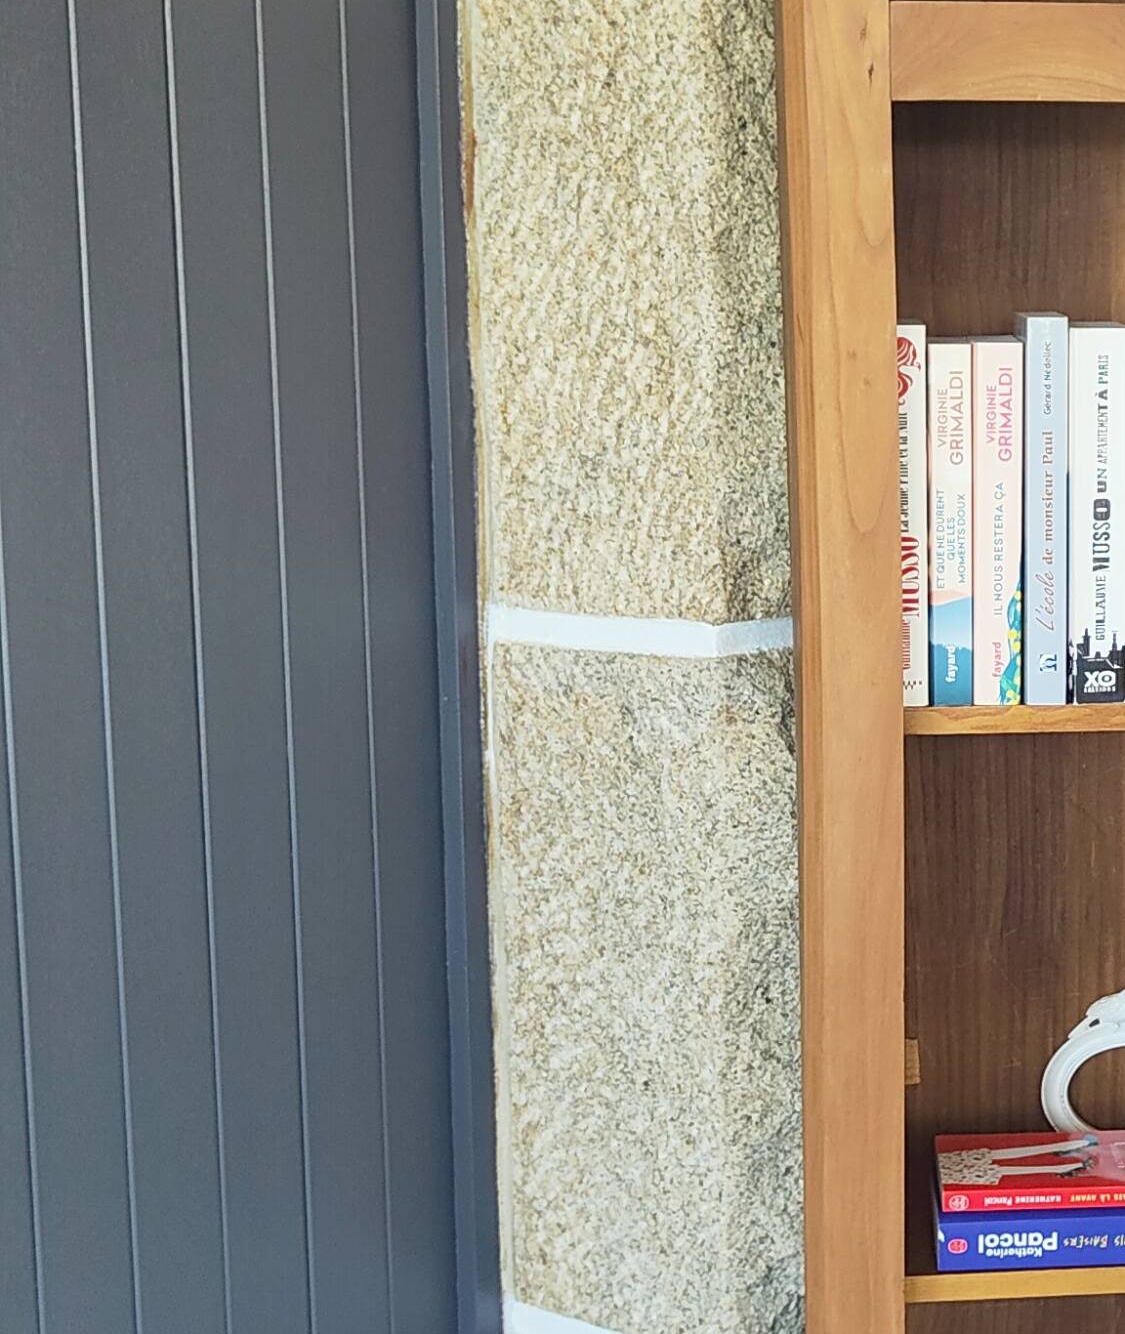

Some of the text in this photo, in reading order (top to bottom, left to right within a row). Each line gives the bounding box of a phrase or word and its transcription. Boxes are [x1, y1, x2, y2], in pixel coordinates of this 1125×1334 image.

[937, 388, 948, 448] VIRGINIE
[949, 370, 964, 465] GRIMALDI
[986, 385, 997, 444] VIRGINIE
[998, 367, 1013, 462] GRIMALDI
[1093, 354, 1111, 641] GUILLAUME MUSSO UN APPARTEMENT À PARIS
[936, 489, 945, 589] ET QUE NE DURENT
[947, 517, 956, 561] QUE LES
[957, 494, 966, 584] MOMENTS DOUX
[994, 482, 1006, 616] IL NOUS RESTERA ÇA
[1035, 431, 1055, 632] L'école de monsieur Paul
[945, 642, 959, 683] fayard
[992, 642, 1005, 678] fayard
[1084, 670, 1117, 688] XO
[984, 1194, 1062, 1207] KATHERINE Pancol
[1071, 1194, 1097, 1202] AVANT
[978, 1231, 1059, 1254] Pancol
[985, 1246, 1043, 1259] Katherine
[1063, 1233, 1108, 1249] BAISERS
